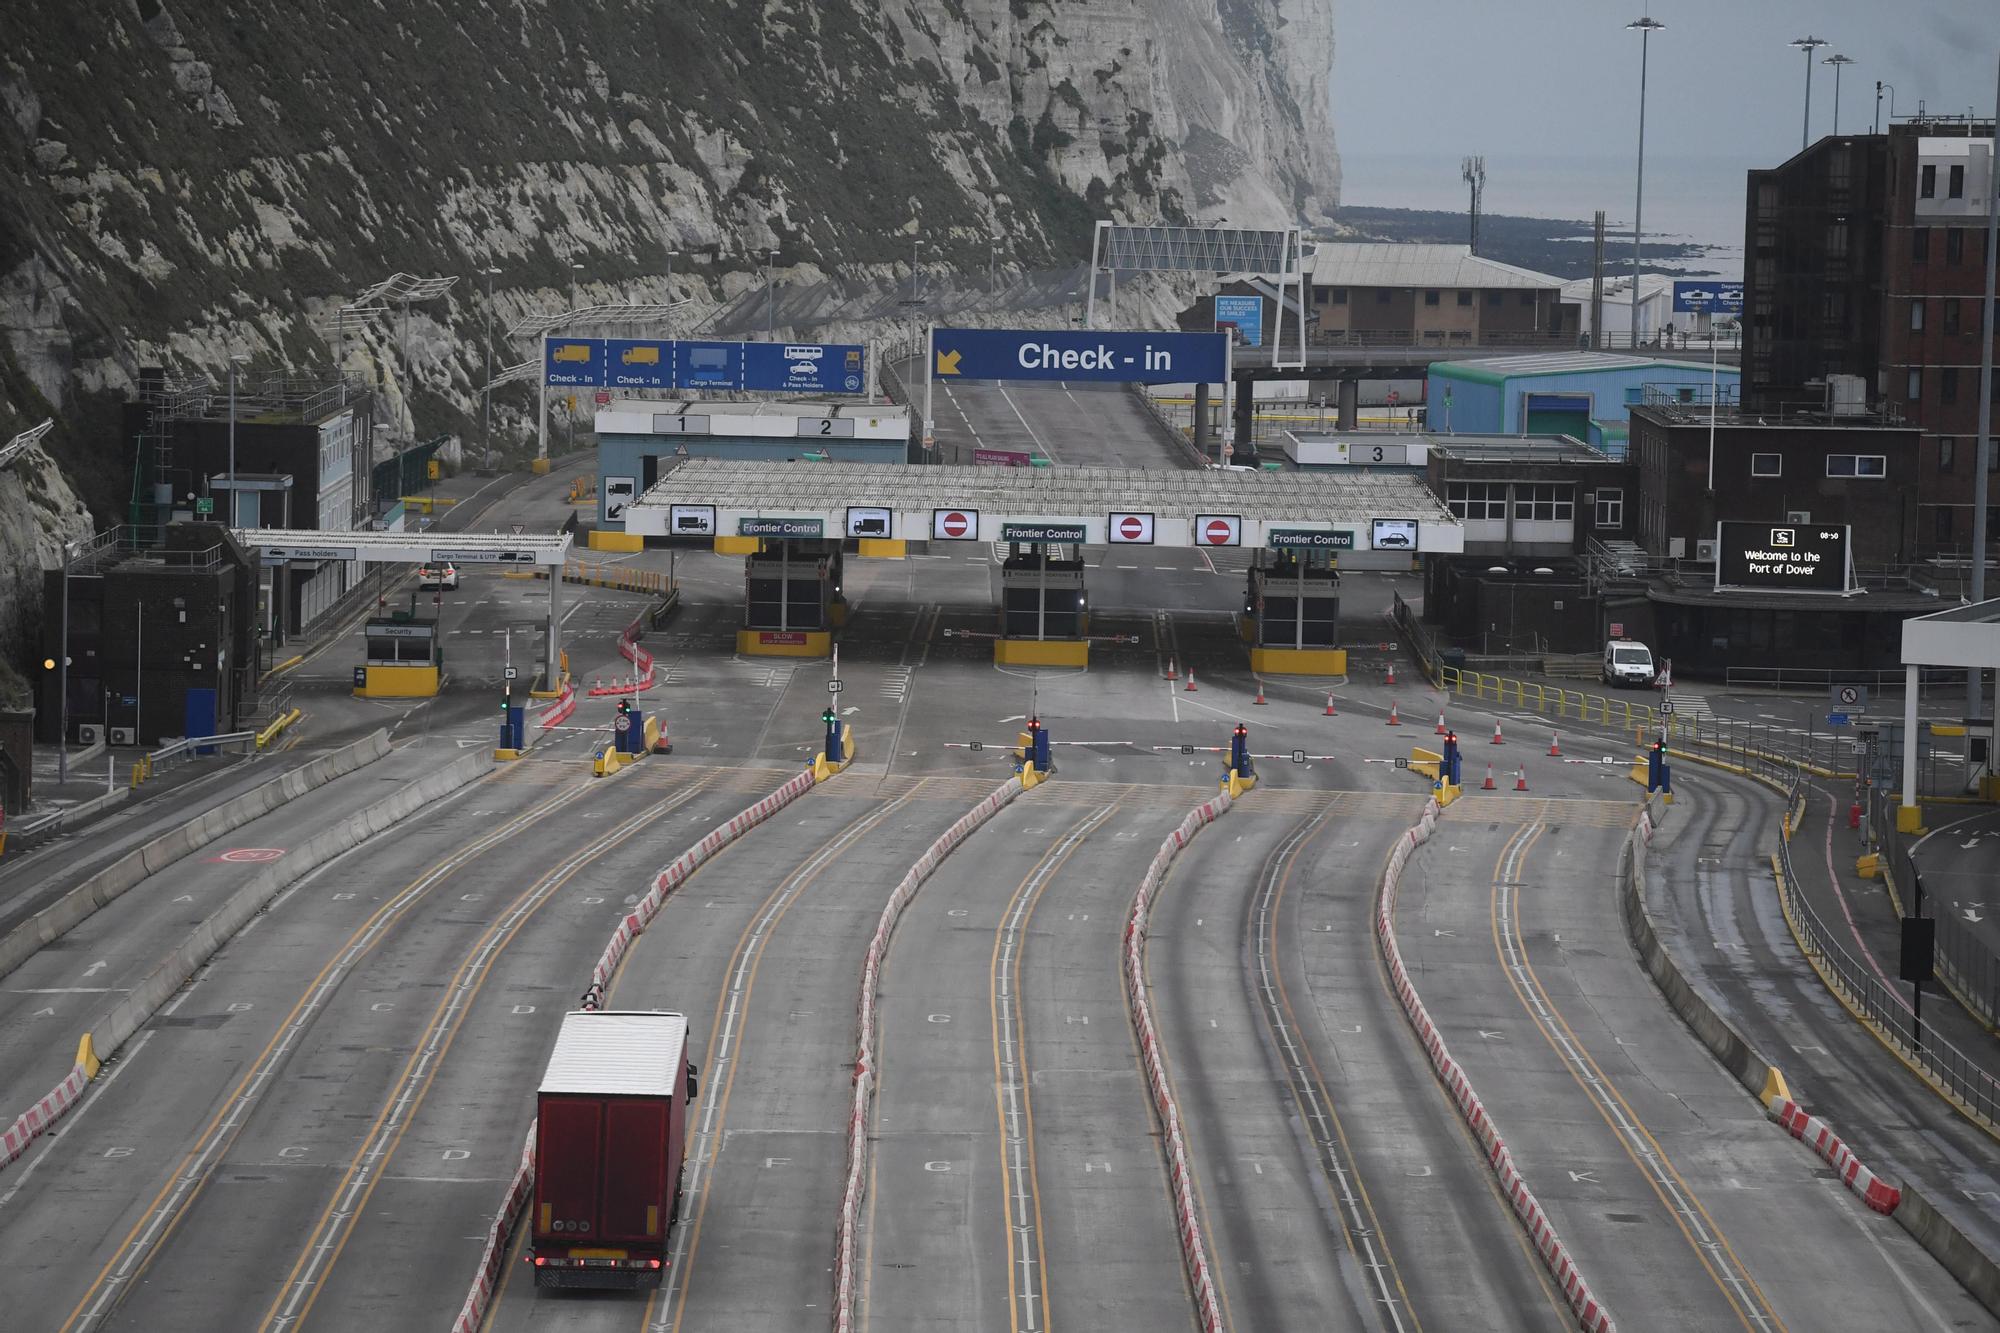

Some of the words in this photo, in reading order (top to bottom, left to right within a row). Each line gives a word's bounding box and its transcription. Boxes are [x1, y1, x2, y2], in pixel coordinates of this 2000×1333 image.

[1018, 343, 1114, 370] Check
[1145, 345, 1172, 371] in
[550, 374, 575, 384] Check
[584, 374, 593, 384] In
[617, 376, 643, 385] Check
[652, 376, 660, 385] In
[678, 416, 686, 432] 1
[820, 420, 832, 435] 2
[1372, 446, 1383, 462] 3
[744, 522, 782, 534] Frontier
[784, 522, 820, 534] Control
[1006, 528, 1044, 538] Frontier
[1046, 528, 1083, 539] Control
[1273, 534, 1311, 545] Frontier
[1313, 534, 1350, 546] Control
[294, 549, 310, 558] Pass
[312, 549, 338, 558] holders
[454, 552, 478, 560] Terminal
[1744, 550, 1788, 560] Welcome
[1790, 552, 1800, 561] to
[1804, 552, 1820, 562] the
[1749, 563, 1770, 574] Port
[1774, 564, 1784, 574] of
[1786, 564, 1816, 575] Dover
[385, 626, 412, 636] Security
[103, 1147, 136, 1158] B
[279, 1146, 310, 1158] C
[442, 1150, 471, 1160] D
[924, 1161, 952, 1172] G
[1085, 1162, 1112, 1172] H
[1568, 1170, 1600, 1183] K
